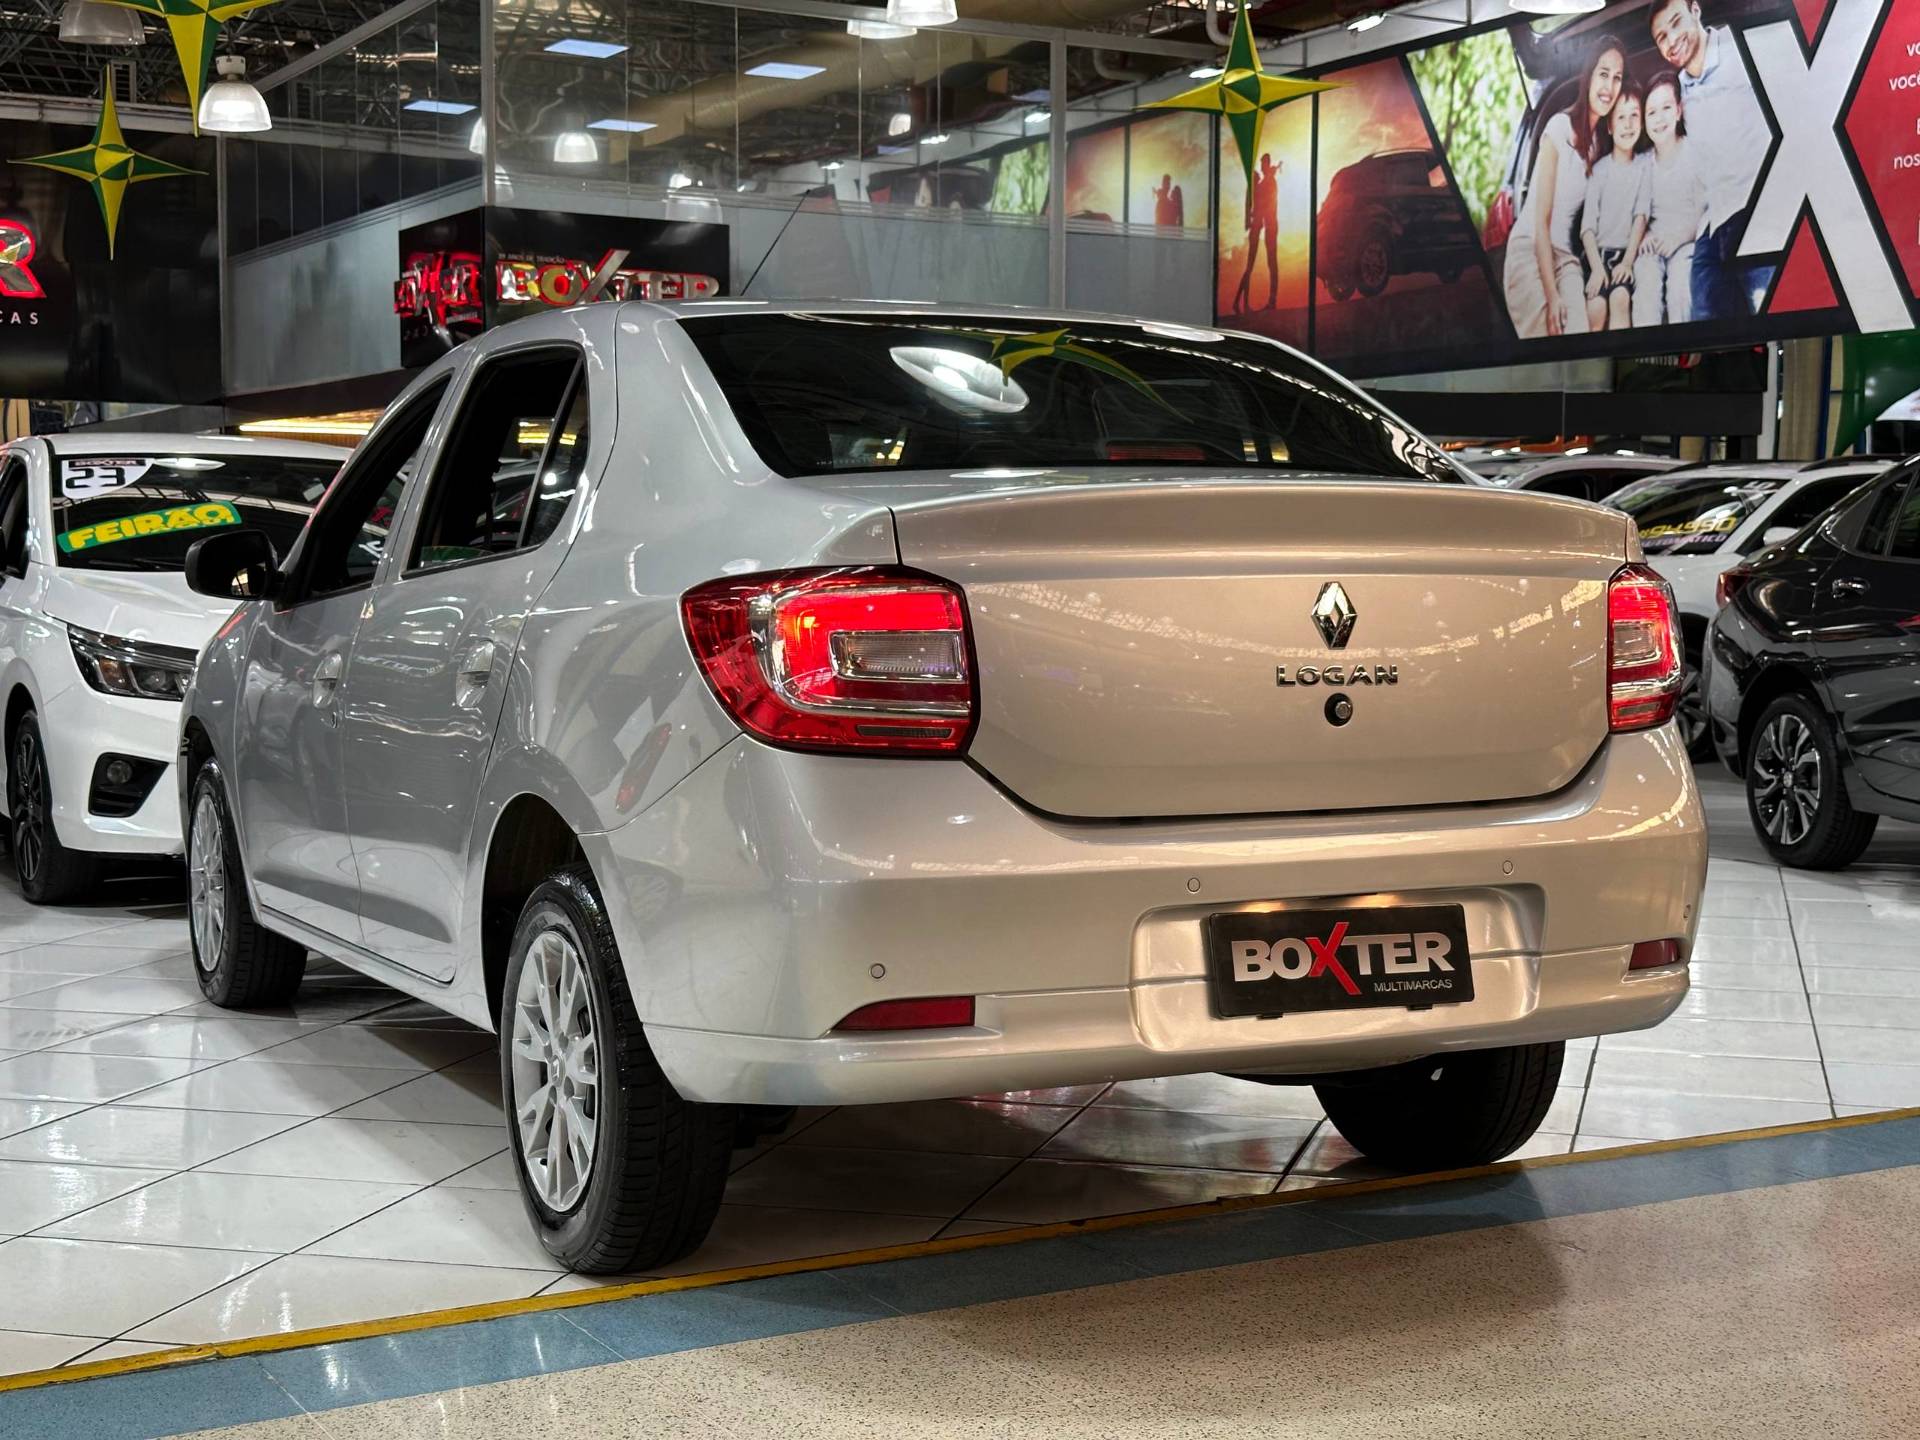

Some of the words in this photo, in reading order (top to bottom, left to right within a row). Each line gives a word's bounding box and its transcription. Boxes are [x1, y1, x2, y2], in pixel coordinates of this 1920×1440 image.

[0, 311, 38, 325] AS
[66, 467, 126, 489] 23
[68, 503, 235, 549] FEIRÃO
[1276, 664, 1399, 687] LOGAN
[1231, 922, 1455, 995] BOXTER
[1374, 979, 1453, 993] MULTIMARCAS
